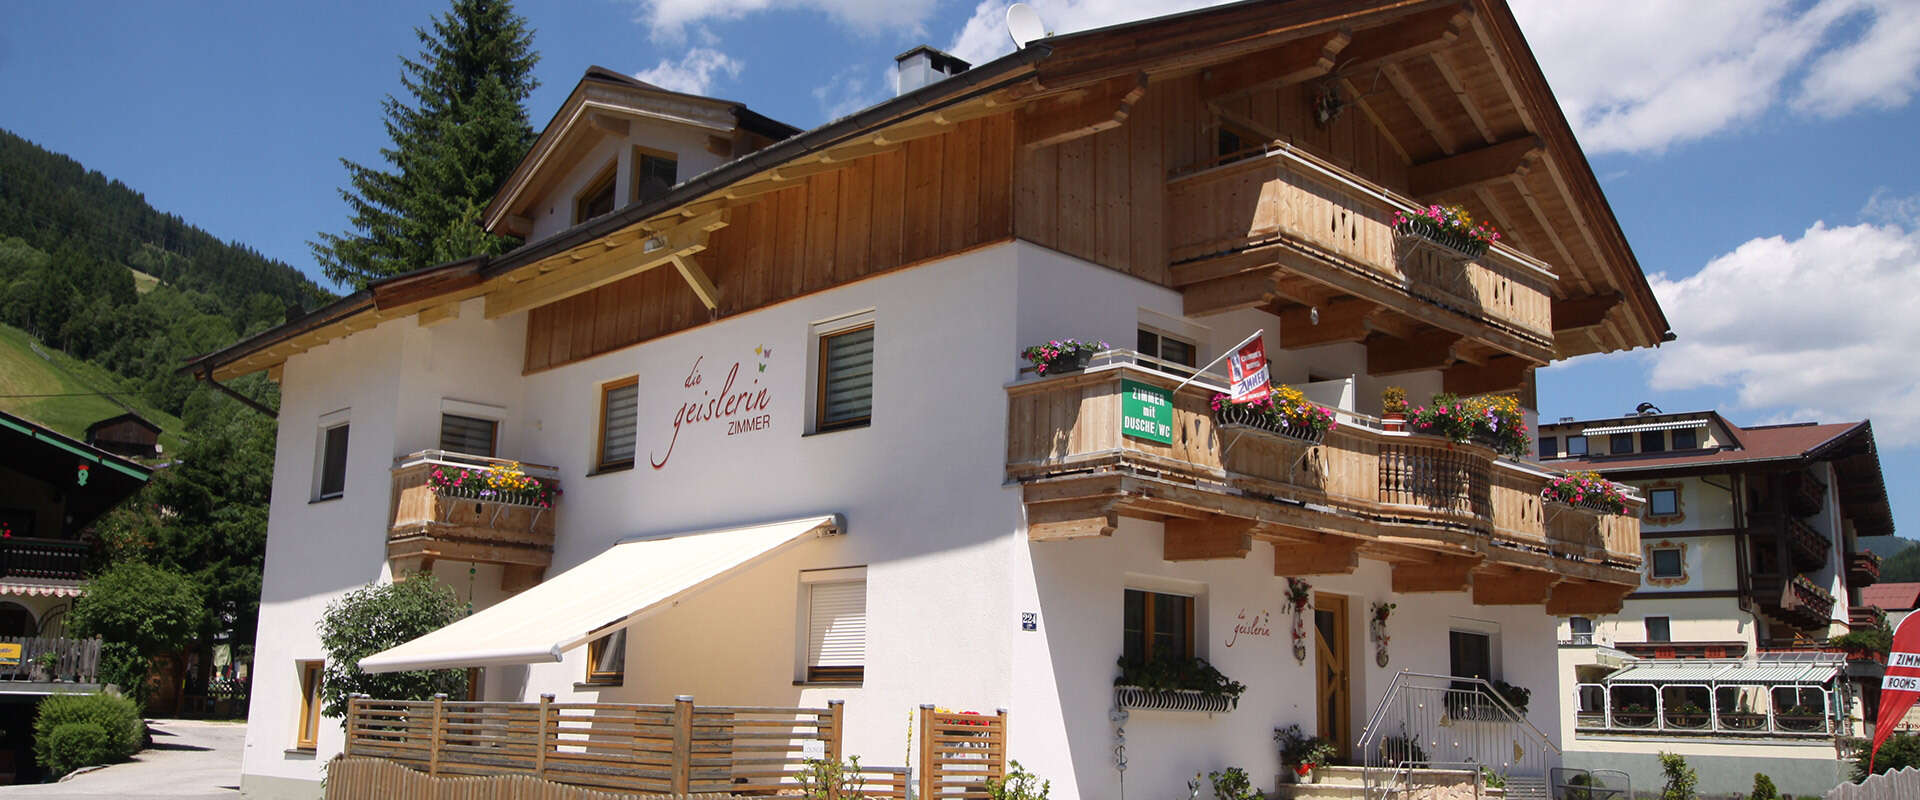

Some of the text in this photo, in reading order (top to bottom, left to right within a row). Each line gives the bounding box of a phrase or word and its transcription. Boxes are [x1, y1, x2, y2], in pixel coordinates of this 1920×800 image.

[685, 356, 703, 388] die
[1238, 369, 1266, 395] ZIMMER
[1132, 387, 1165, 407] ZIMMER
[650, 362, 771, 470] geislerin
[1143, 406, 1156, 418] mit
[728, 414, 771, 436] ZIMMER
[1888, 677, 1917, 689] ROOMS
